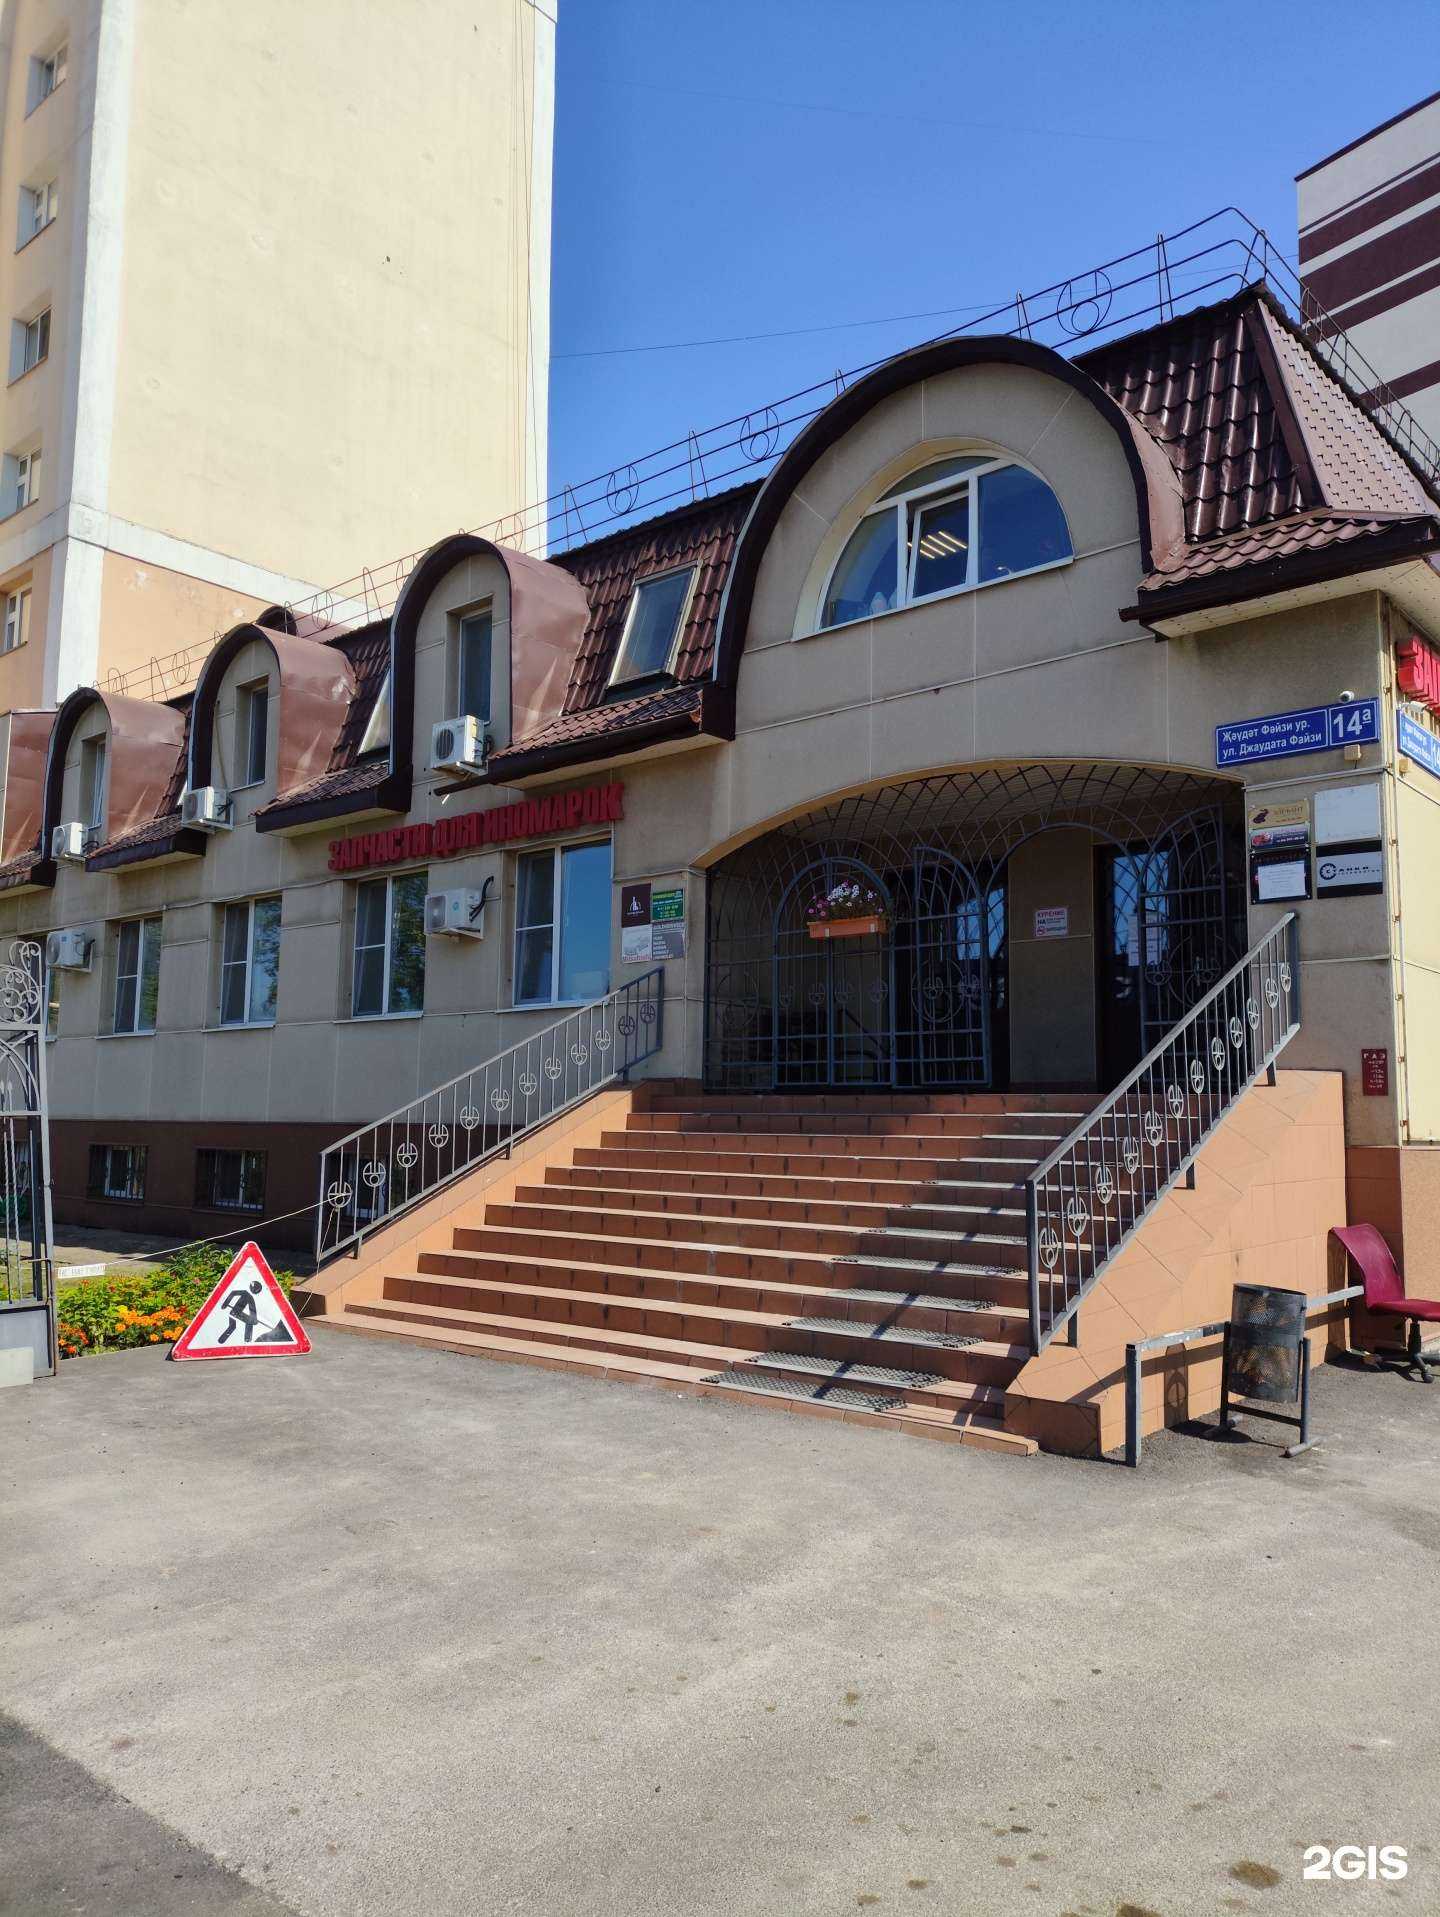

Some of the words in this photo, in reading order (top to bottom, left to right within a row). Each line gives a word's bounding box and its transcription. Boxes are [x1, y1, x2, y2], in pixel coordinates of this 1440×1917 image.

[1261, 722, 1293, 736] Фәйзи
[1295, 719, 1310, 733] ур.
[1222, 747, 1237, 760] ул.
[1239, 738, 1287, 756] Джаудата
[1289, 731, 1322, 746] Файзи
[328, 823, 432, 870] ЗАПЧАСТИ
[433, 811, 485, 857] ДЛЯ
[485, 782, 624, 844] ИНОМАРОК
